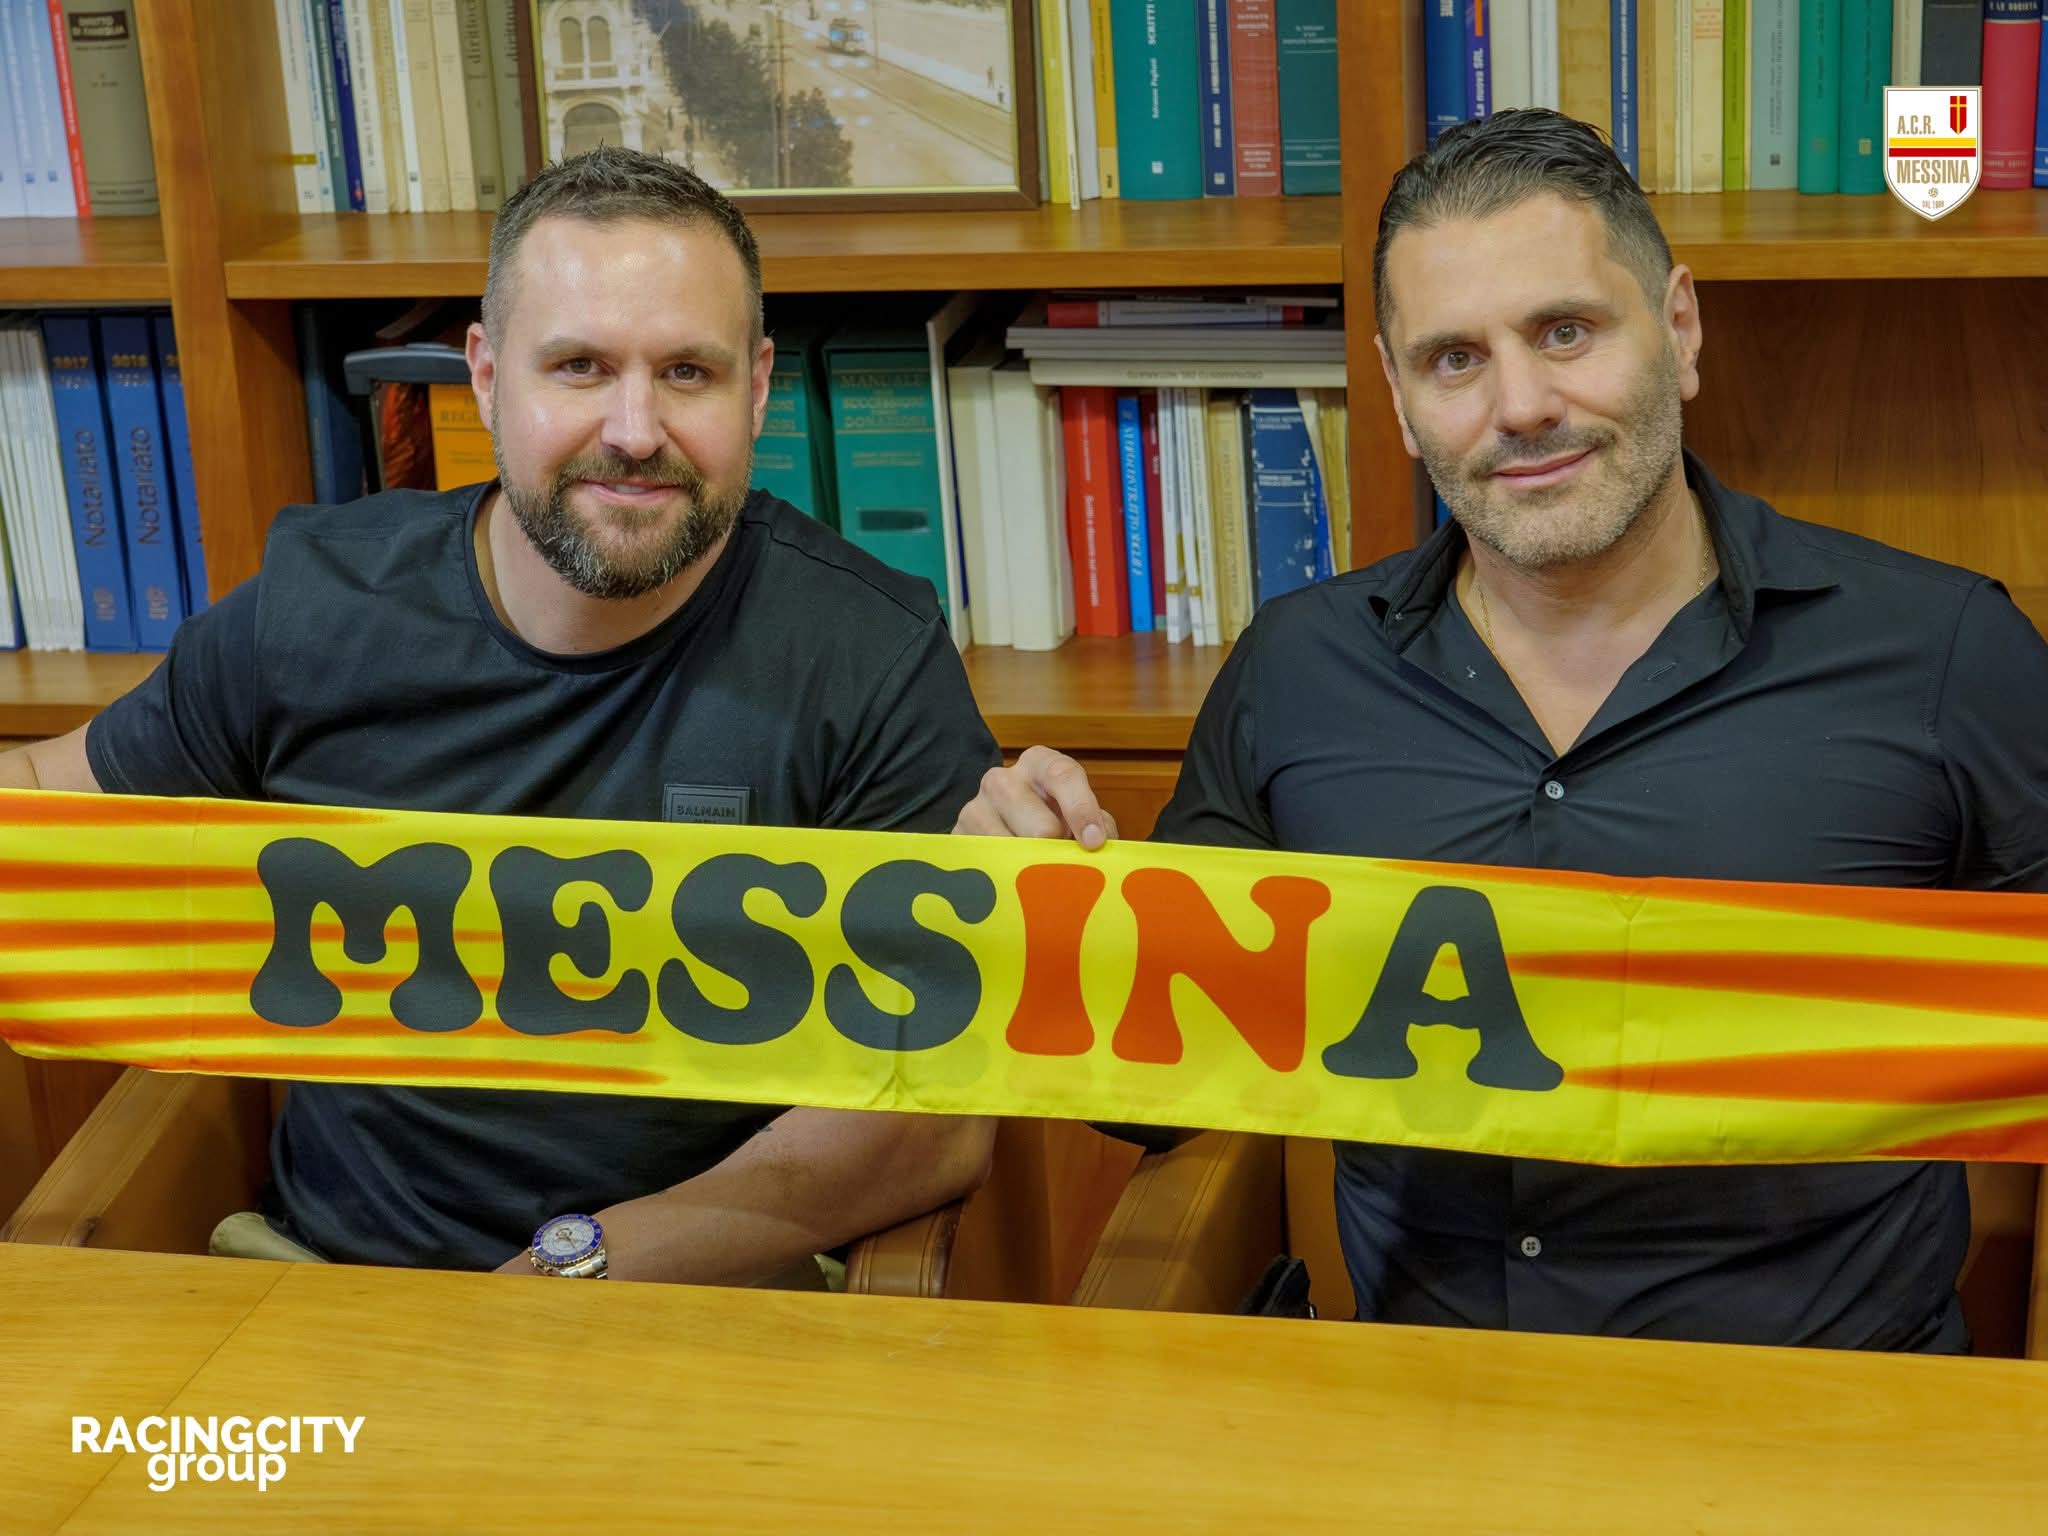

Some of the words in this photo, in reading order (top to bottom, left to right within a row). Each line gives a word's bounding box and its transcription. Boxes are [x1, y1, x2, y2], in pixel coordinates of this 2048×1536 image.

[1146, 3, 1156, 45] SCRITTI
[75, 429, 107, 547] Notariato
[129, 427, 163, 545] Notariato
[676, 805, 736, 817] BALMAIN
[250, 836, 1563, 1091] MESSINA
